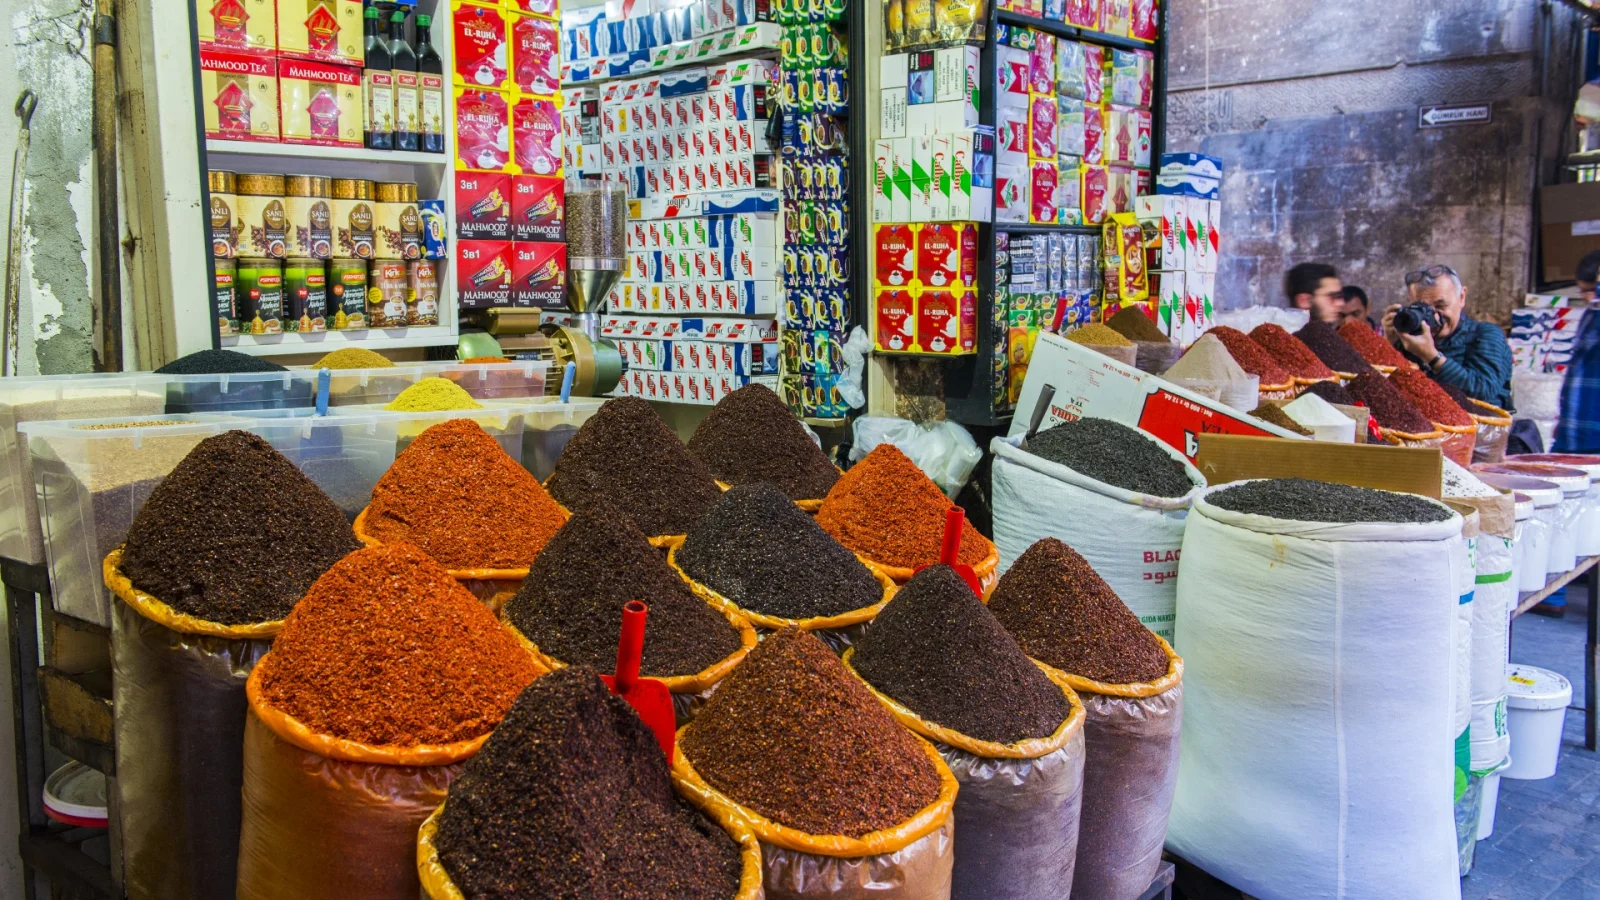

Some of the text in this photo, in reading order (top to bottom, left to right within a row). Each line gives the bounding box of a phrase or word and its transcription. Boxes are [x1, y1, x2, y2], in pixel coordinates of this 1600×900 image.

[464, 28, 496, 40] EL-RUHA
[522, 40, 550, 51] EL-RUHA
[250, 62, 266, 74] TEA
[290, 66, 354, 82] MAHMOOD TEA
[466, 114, 499, 123] EL-RUHA
[523, 122, 554, 130] EL-RUHA
[934, 152, 944, 192] Calbor
[954, 151, 965, 191] Calbor
[462, 222, 506, 231] MAHMOOD
[518, 224, 560, 233] MAHMOOD
[464, 291, 508, 300] MAHMOOD
[518, 291, 560, 301] MAHMOOD
[1143, 549, 1181, 563] BLAC
